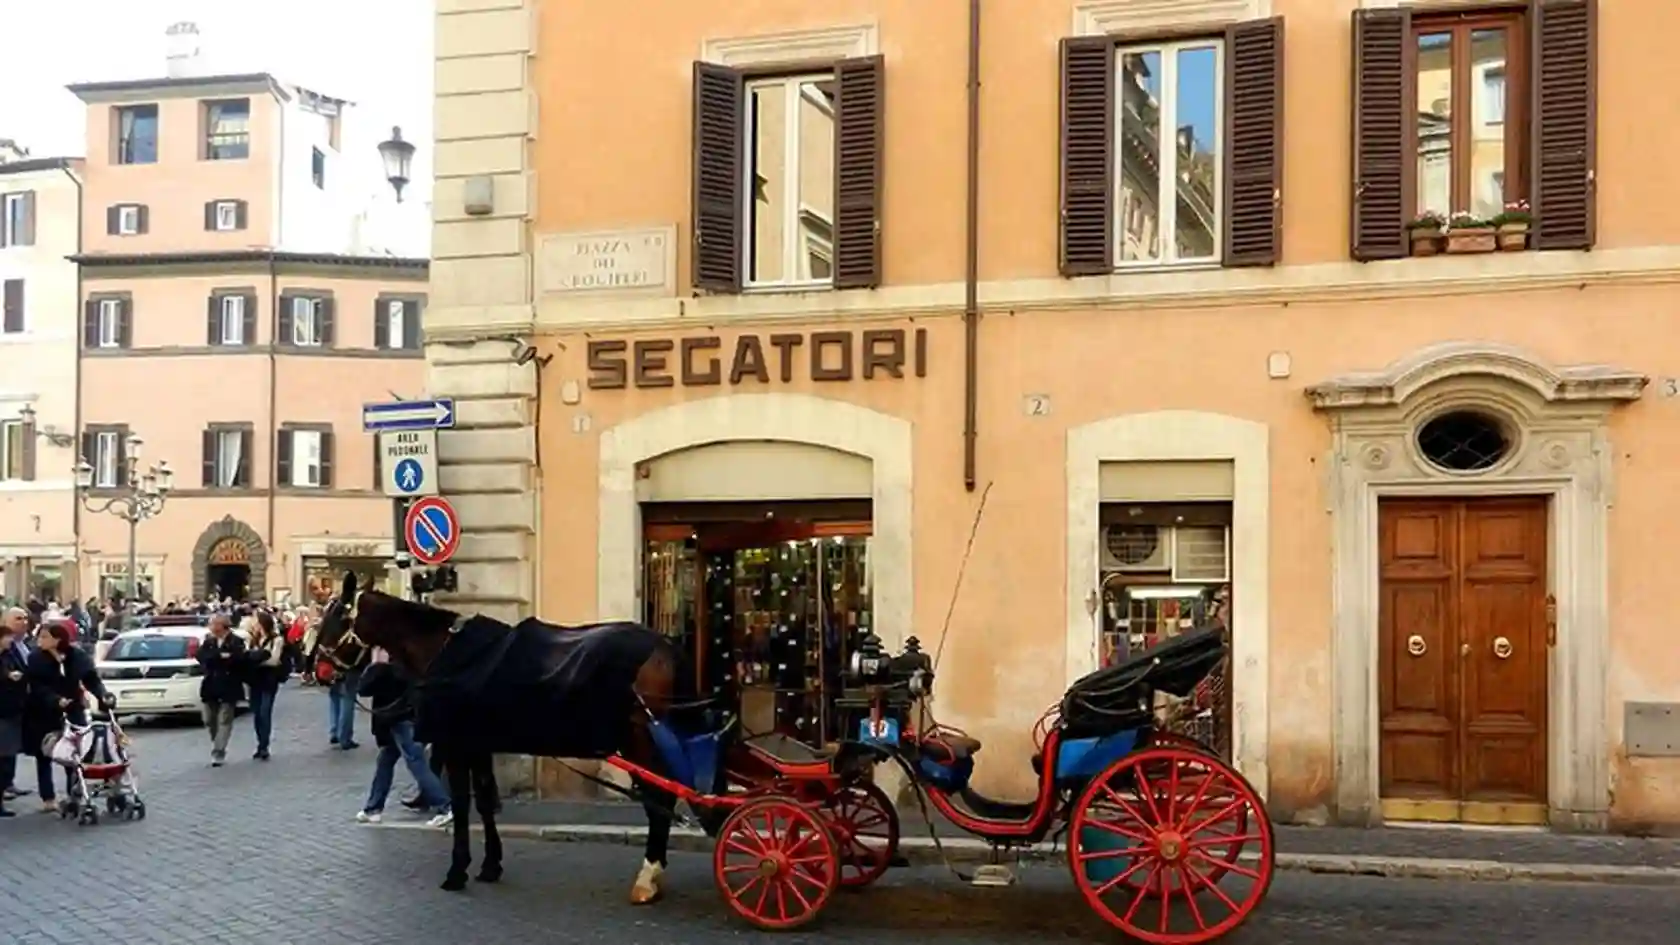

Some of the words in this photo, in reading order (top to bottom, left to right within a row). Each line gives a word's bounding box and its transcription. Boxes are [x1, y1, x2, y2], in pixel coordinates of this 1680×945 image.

[575, 239, 631, 255] PIAZZA
[587, 328, 927, 390] SEGATORI
[1032, 398, 1042, 416] 2
